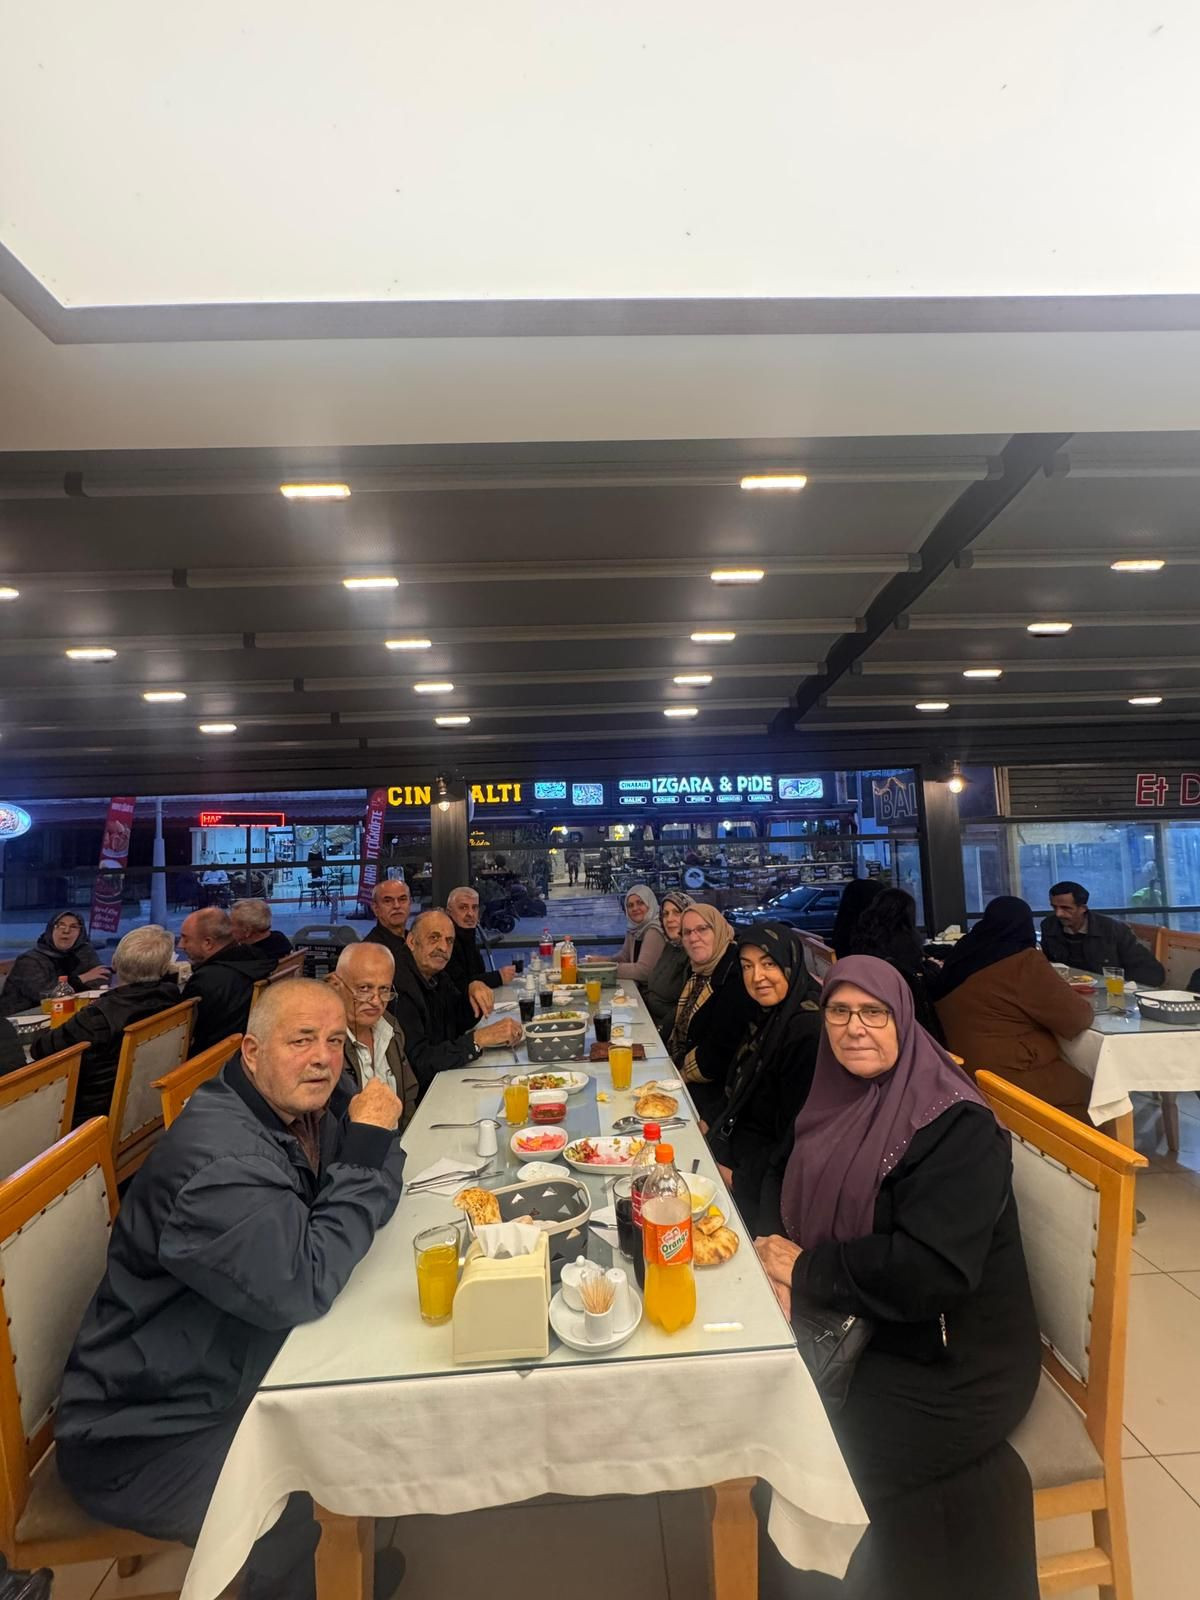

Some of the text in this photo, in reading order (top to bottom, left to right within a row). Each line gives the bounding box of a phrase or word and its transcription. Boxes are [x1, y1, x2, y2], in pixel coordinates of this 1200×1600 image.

[652, 777, 714, 793] IZGARA
[719, 776, 732, 792] &
[1135, 773, 1169, 807] Et
